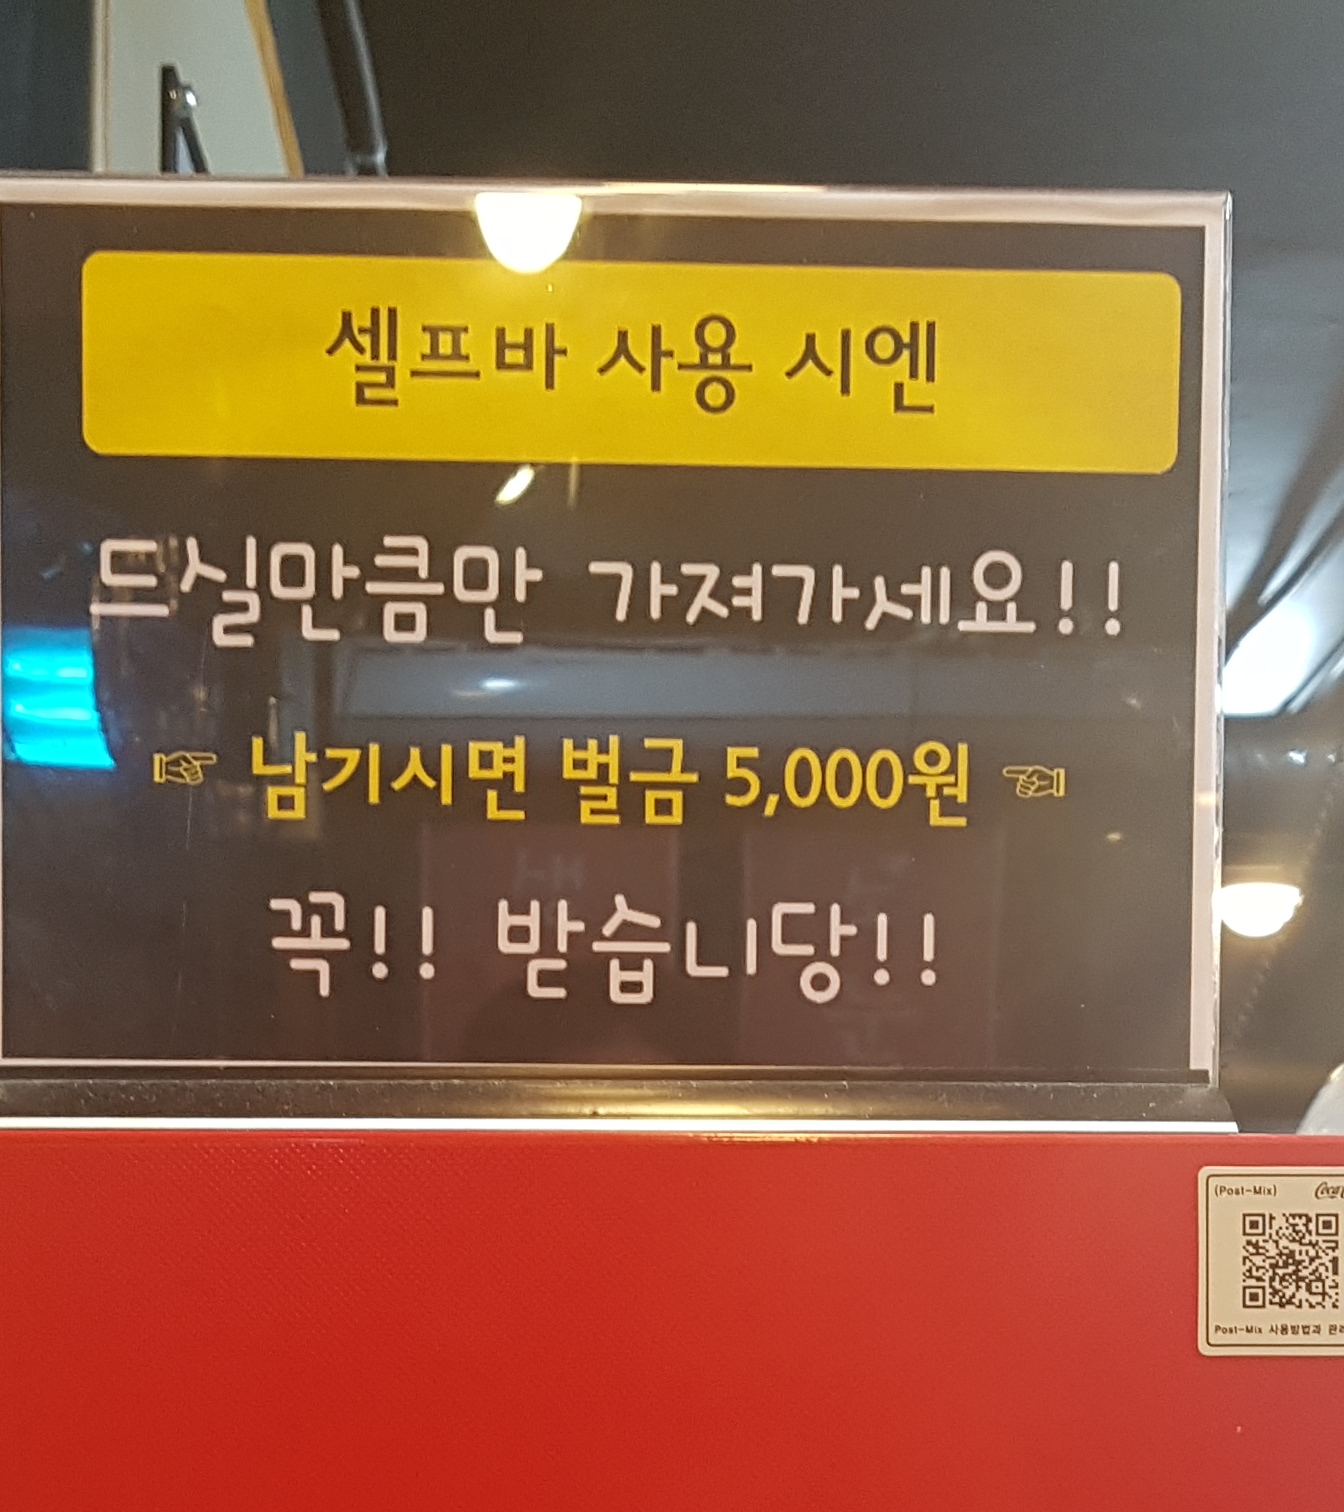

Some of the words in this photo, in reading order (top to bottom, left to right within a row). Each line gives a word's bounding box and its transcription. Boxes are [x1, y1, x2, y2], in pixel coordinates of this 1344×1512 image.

[324, 302, 568, 408] 셀프바
[597, 310, 754, 417] 사용
[783, 317, 942, 420] 시엔
[89, 533, 543, 649] 드실만큼만
[587, 543, 1125, 640] 가져가세요!!
[250, 731, 529, 824] 남기시면
[560, 733, 698, 826] 벌금
[724, 738, 974, 828] 5,000원
[267, 896, 437, 999] 꼭!!
[494, 894, 939, 1006] 받습니당!!
[1214, 1184, 1277, 1198] (Post-Mix)
[1214, 1324, 1262, 1335] Post-Mix
[1269, 1324, 1321, 1336] 사용방법과
